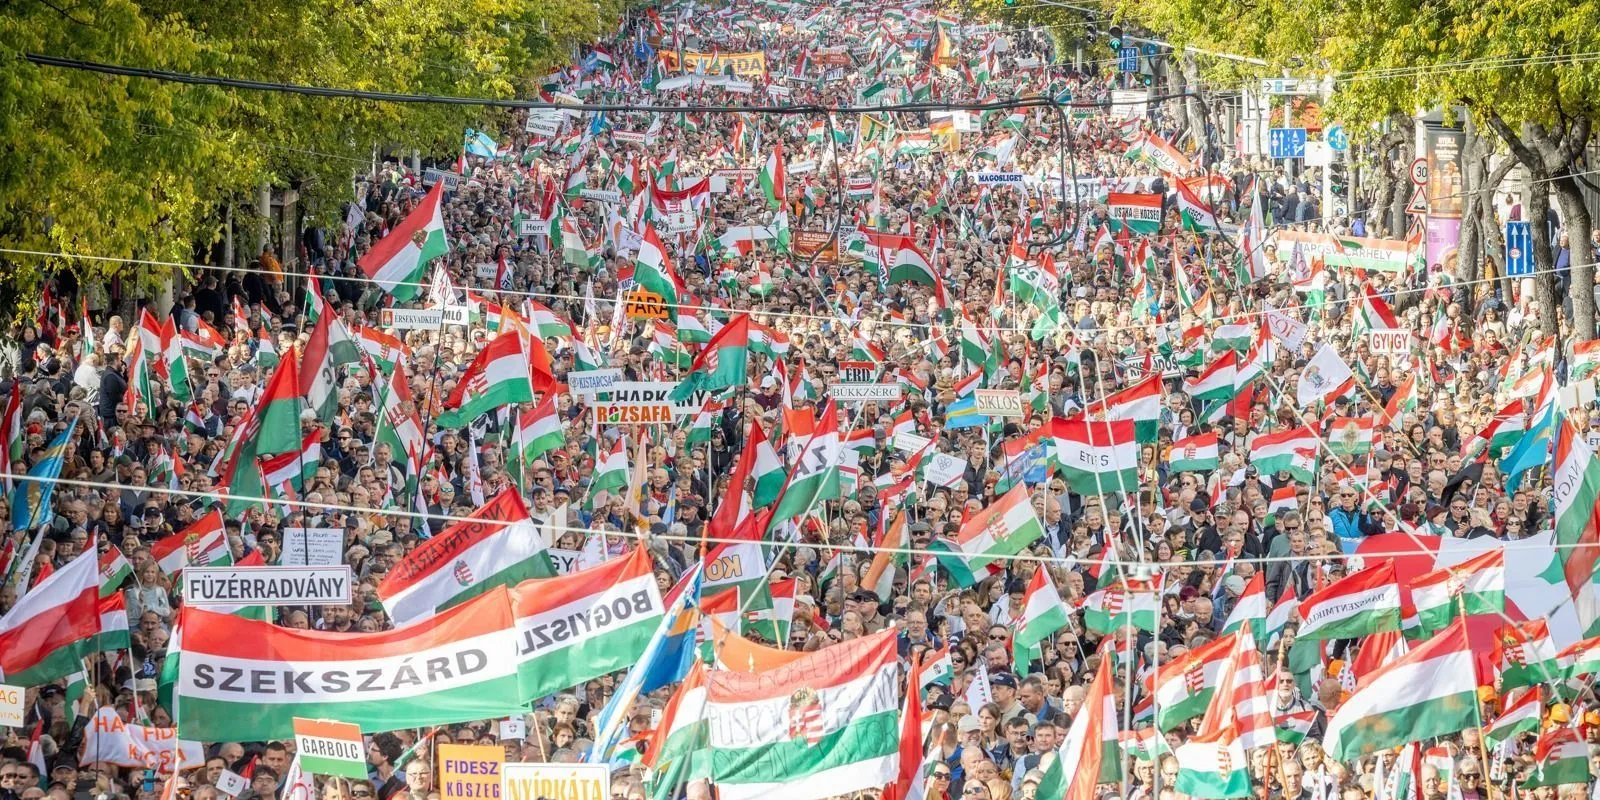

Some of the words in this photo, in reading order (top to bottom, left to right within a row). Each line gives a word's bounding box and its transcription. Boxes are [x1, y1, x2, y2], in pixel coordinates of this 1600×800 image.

[978, 174, 1023, 182] MAGOSLIGET
[1416, 166, 1427, 178] 30
[844, 364, 871, 383] ÉRD
[596, 402, 673, 423] RÓZSAFA
[189, 572, 350, 600] FÜZÉRRADVÁNY
[192, 647, 488, 695] SZEKSZÁRD
[302, 737, 359, 760] GARBOLC
[445, 759, 499, 775] FIDESZ
